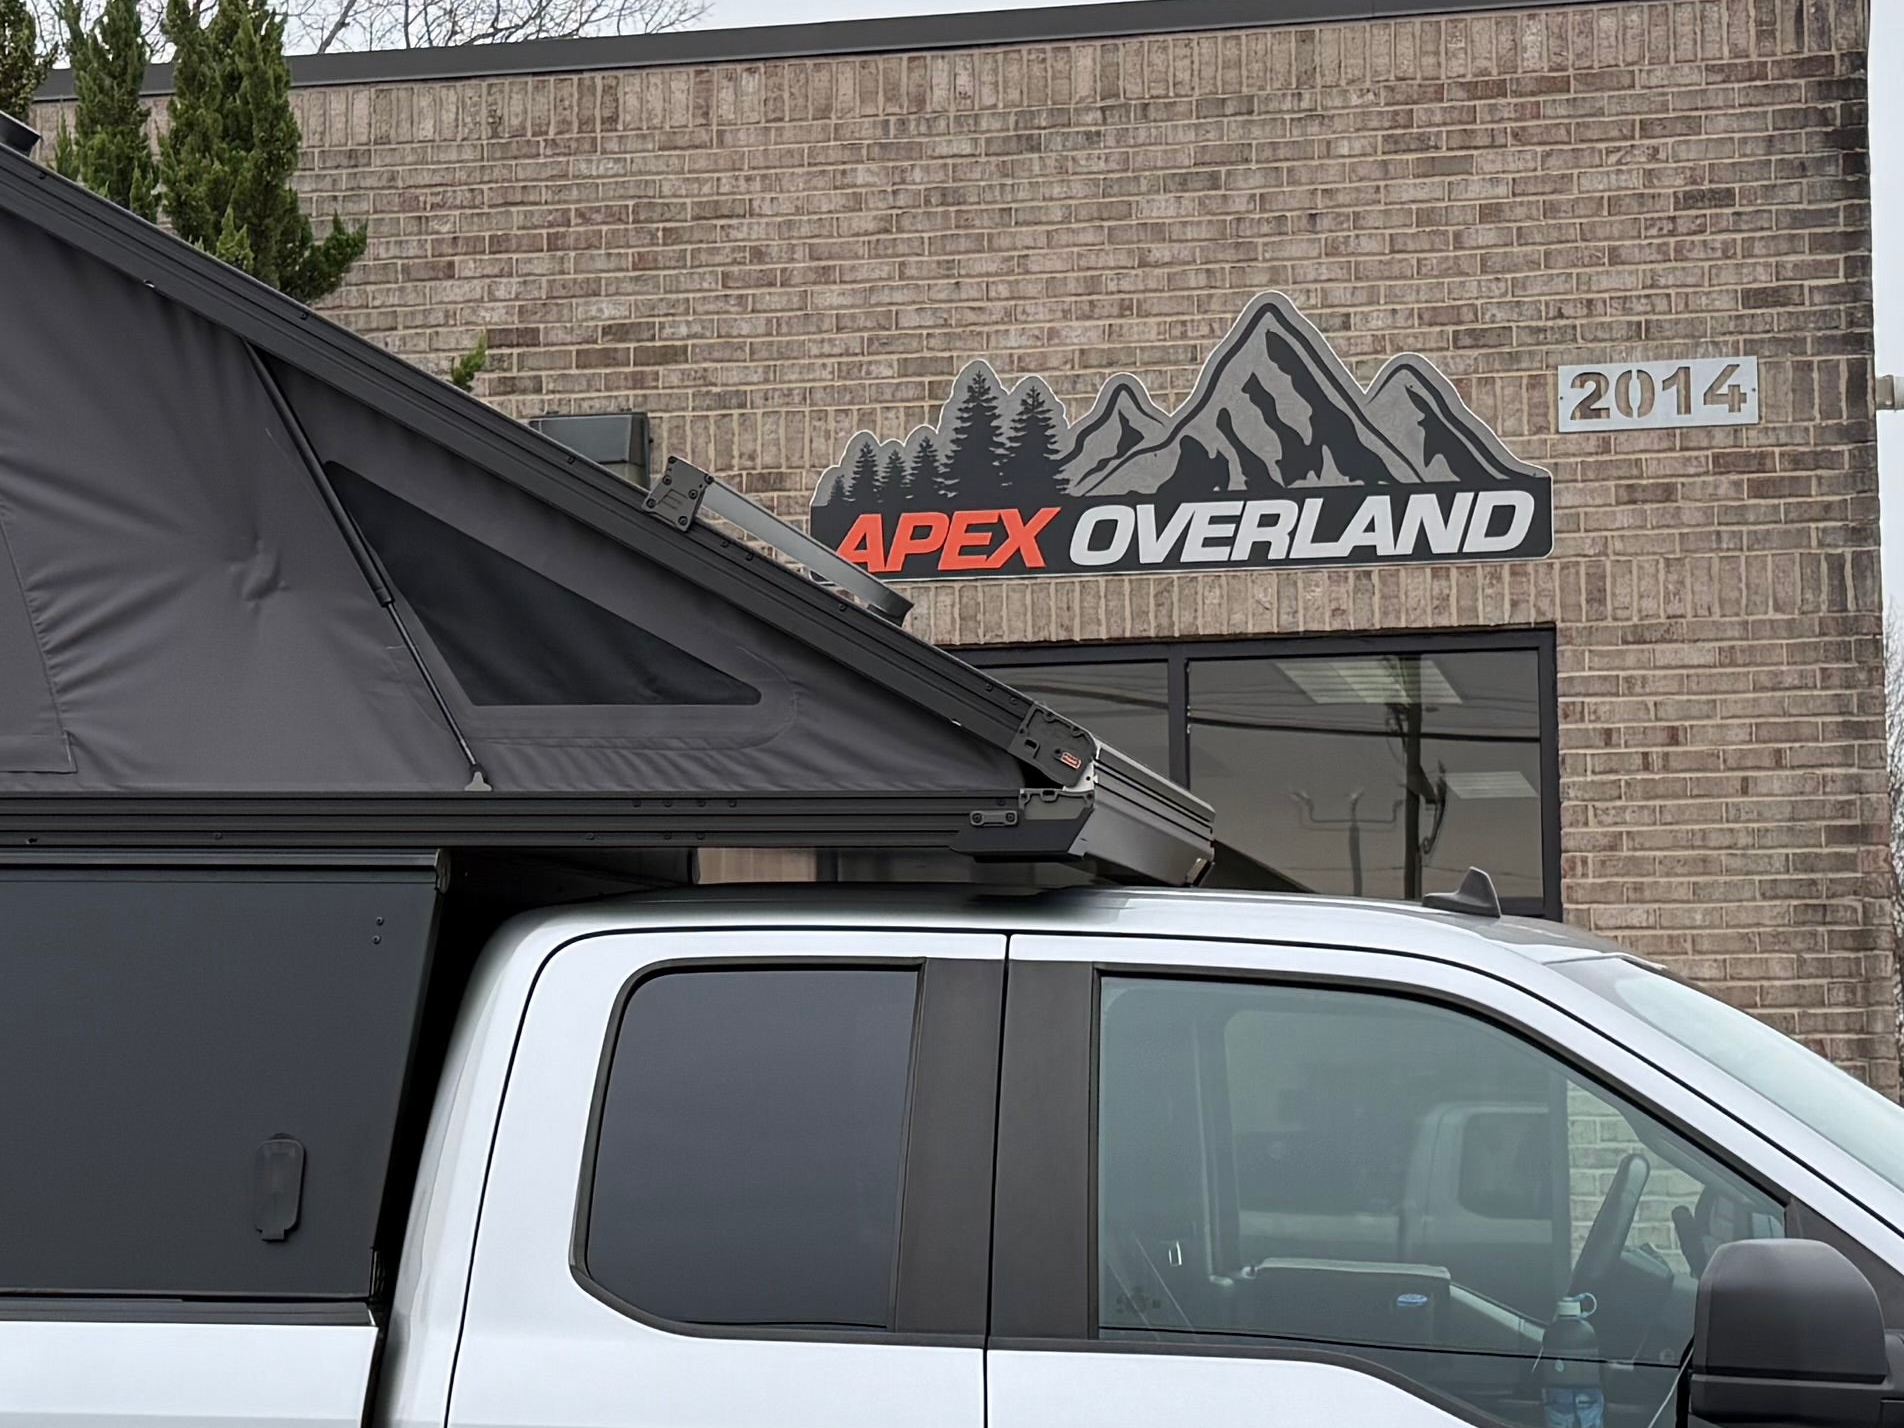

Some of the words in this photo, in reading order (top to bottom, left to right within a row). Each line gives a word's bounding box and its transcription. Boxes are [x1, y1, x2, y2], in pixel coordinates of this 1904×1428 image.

[1571, 360, 1748, 423] 2014
[836, 507, 1061, 572] APEX
[1069, 489, 1537, 567] OVERLAND
